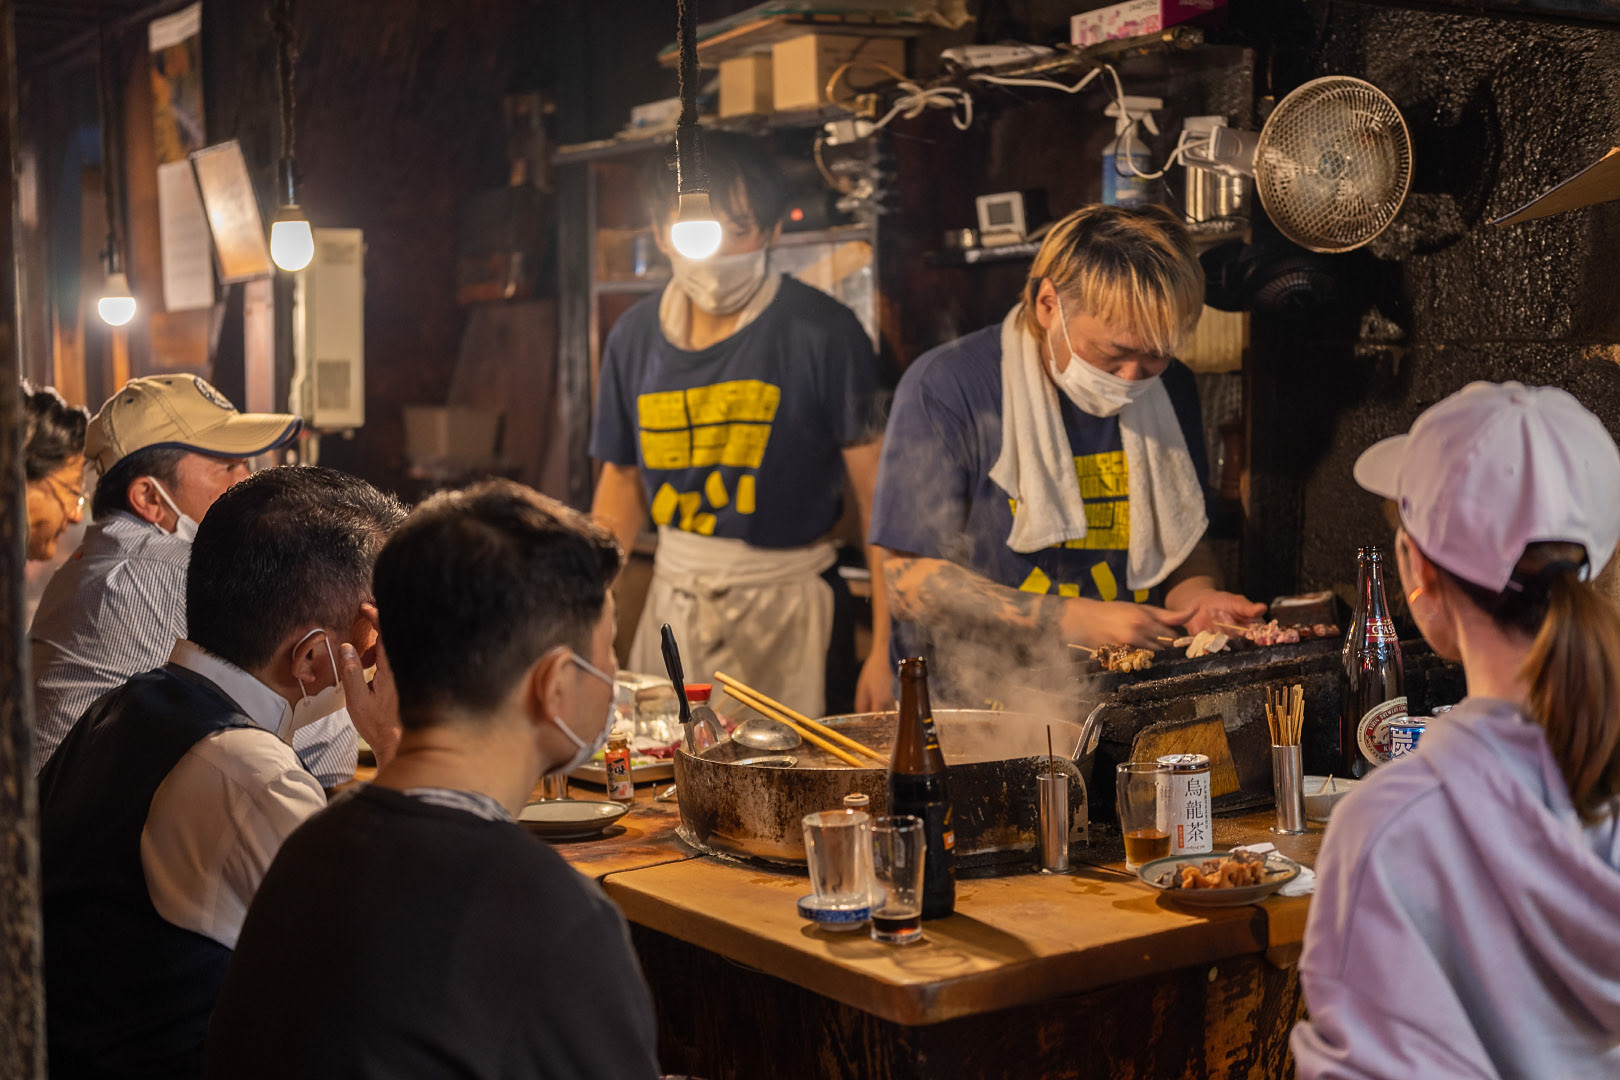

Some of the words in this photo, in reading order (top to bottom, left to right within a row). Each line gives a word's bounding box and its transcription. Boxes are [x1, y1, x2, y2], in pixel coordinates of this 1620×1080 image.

[1391, 730, 1413, 757] 炭
[1185, 777, 1204, 843] 烏龍茶
